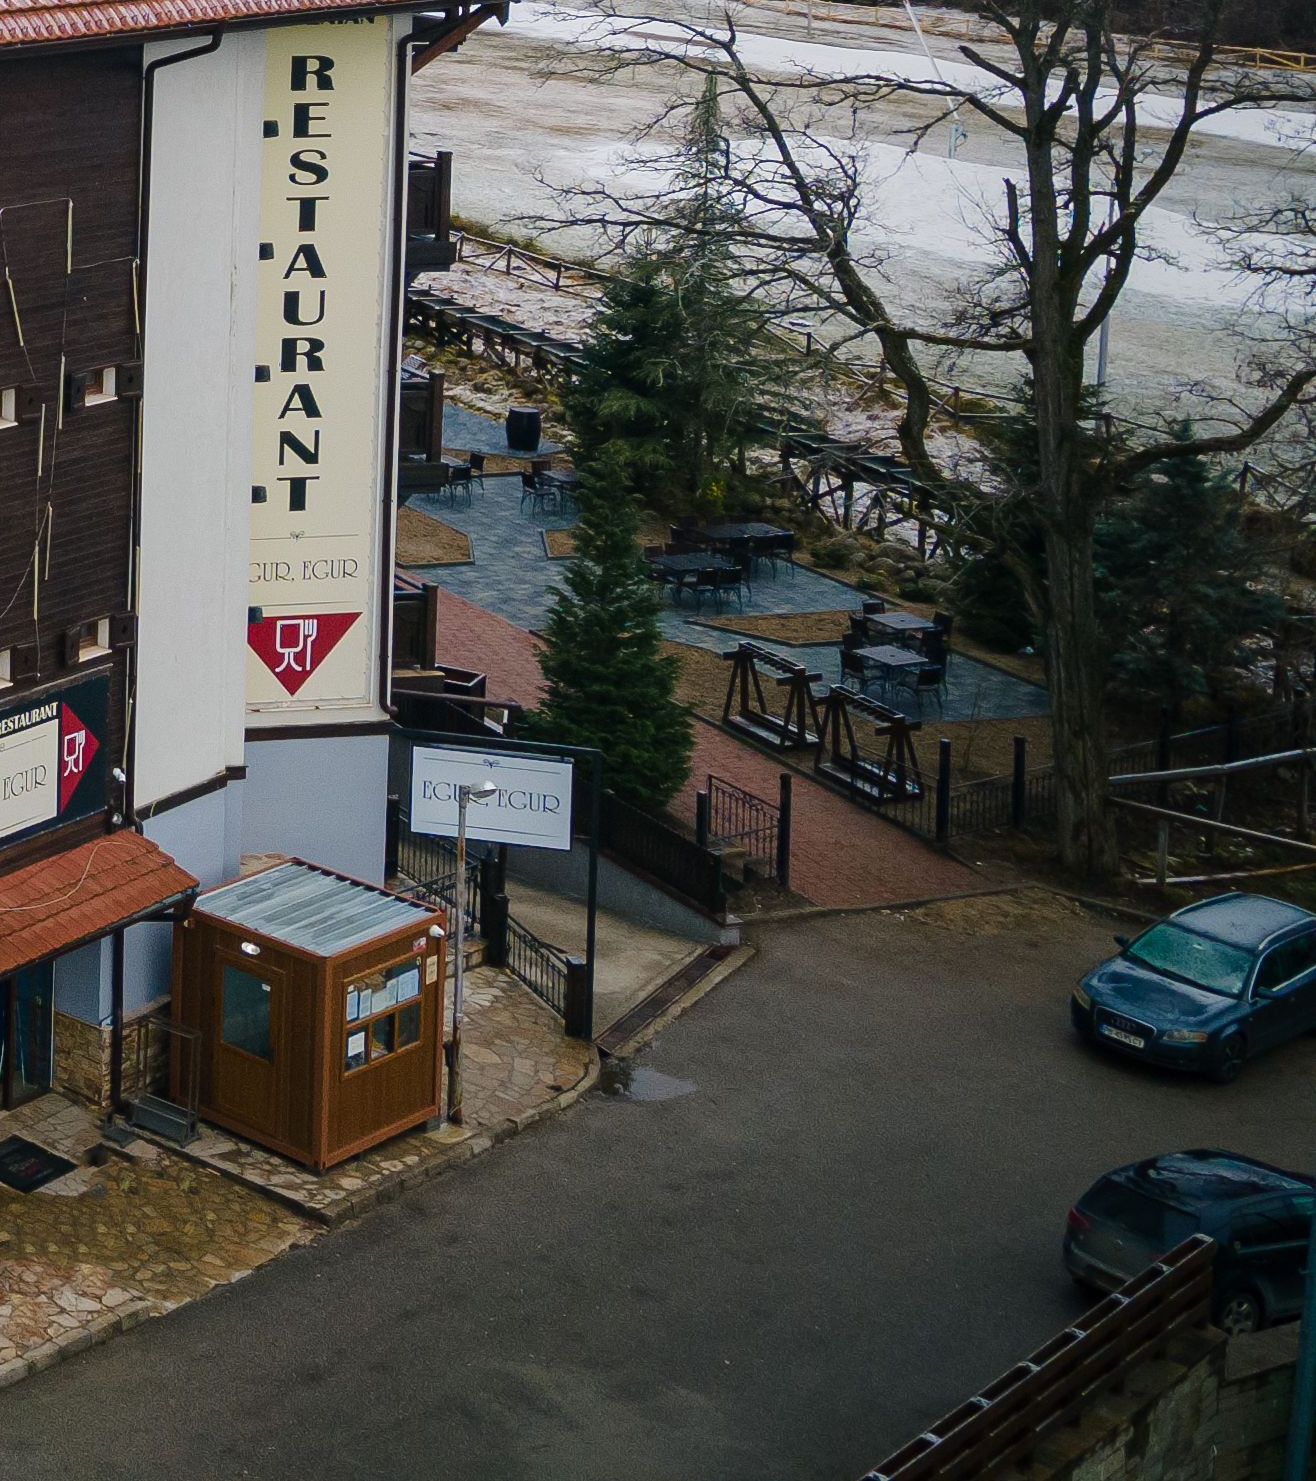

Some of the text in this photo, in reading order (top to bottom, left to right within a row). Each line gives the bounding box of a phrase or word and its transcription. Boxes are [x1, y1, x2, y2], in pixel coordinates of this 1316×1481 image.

[276, 55, 335, 512] RESTAURANT
[249, 559, 358, 583] GUR, EGUR
[2, 764, 47, 801] EGUR
[497, 788, 561, 815] EGUR
